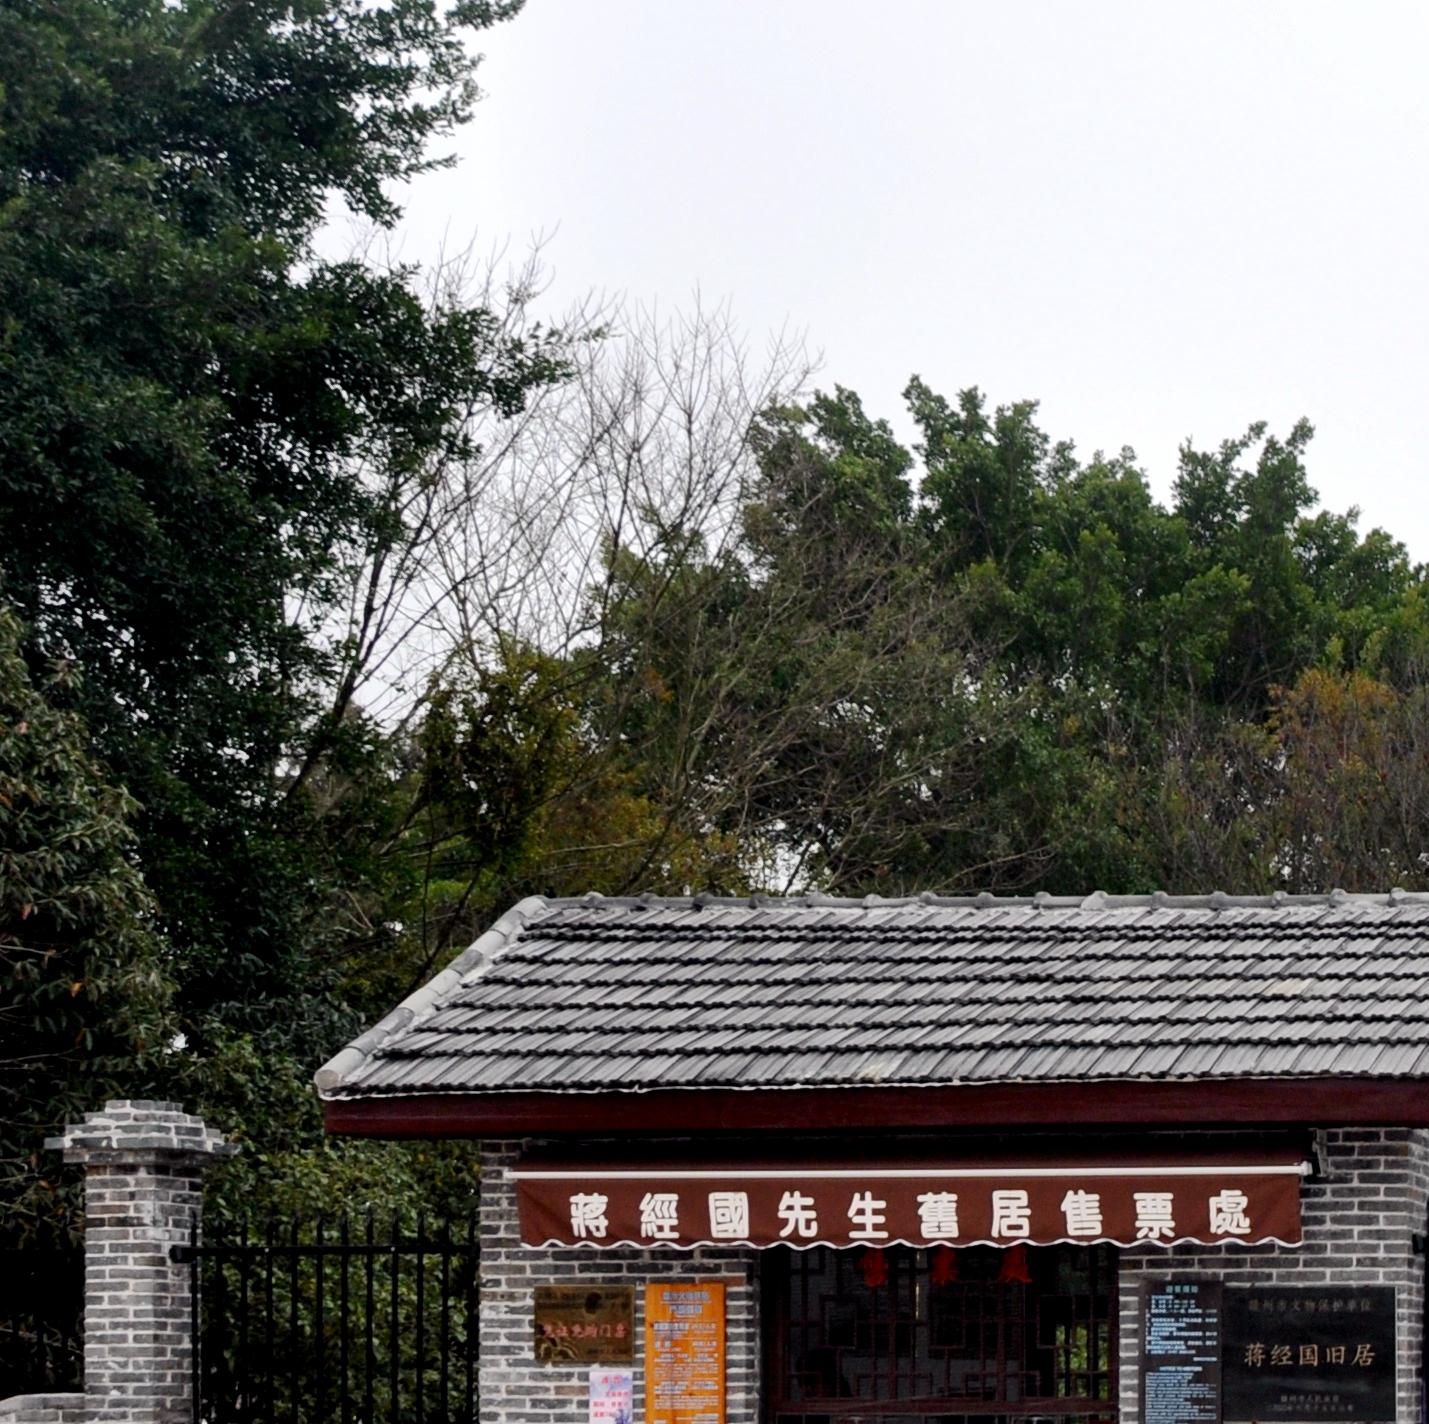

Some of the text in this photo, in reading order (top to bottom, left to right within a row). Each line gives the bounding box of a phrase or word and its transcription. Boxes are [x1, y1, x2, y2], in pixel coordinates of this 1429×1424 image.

[1244, 1342, 1376, 1368] 蒋经国旧居
